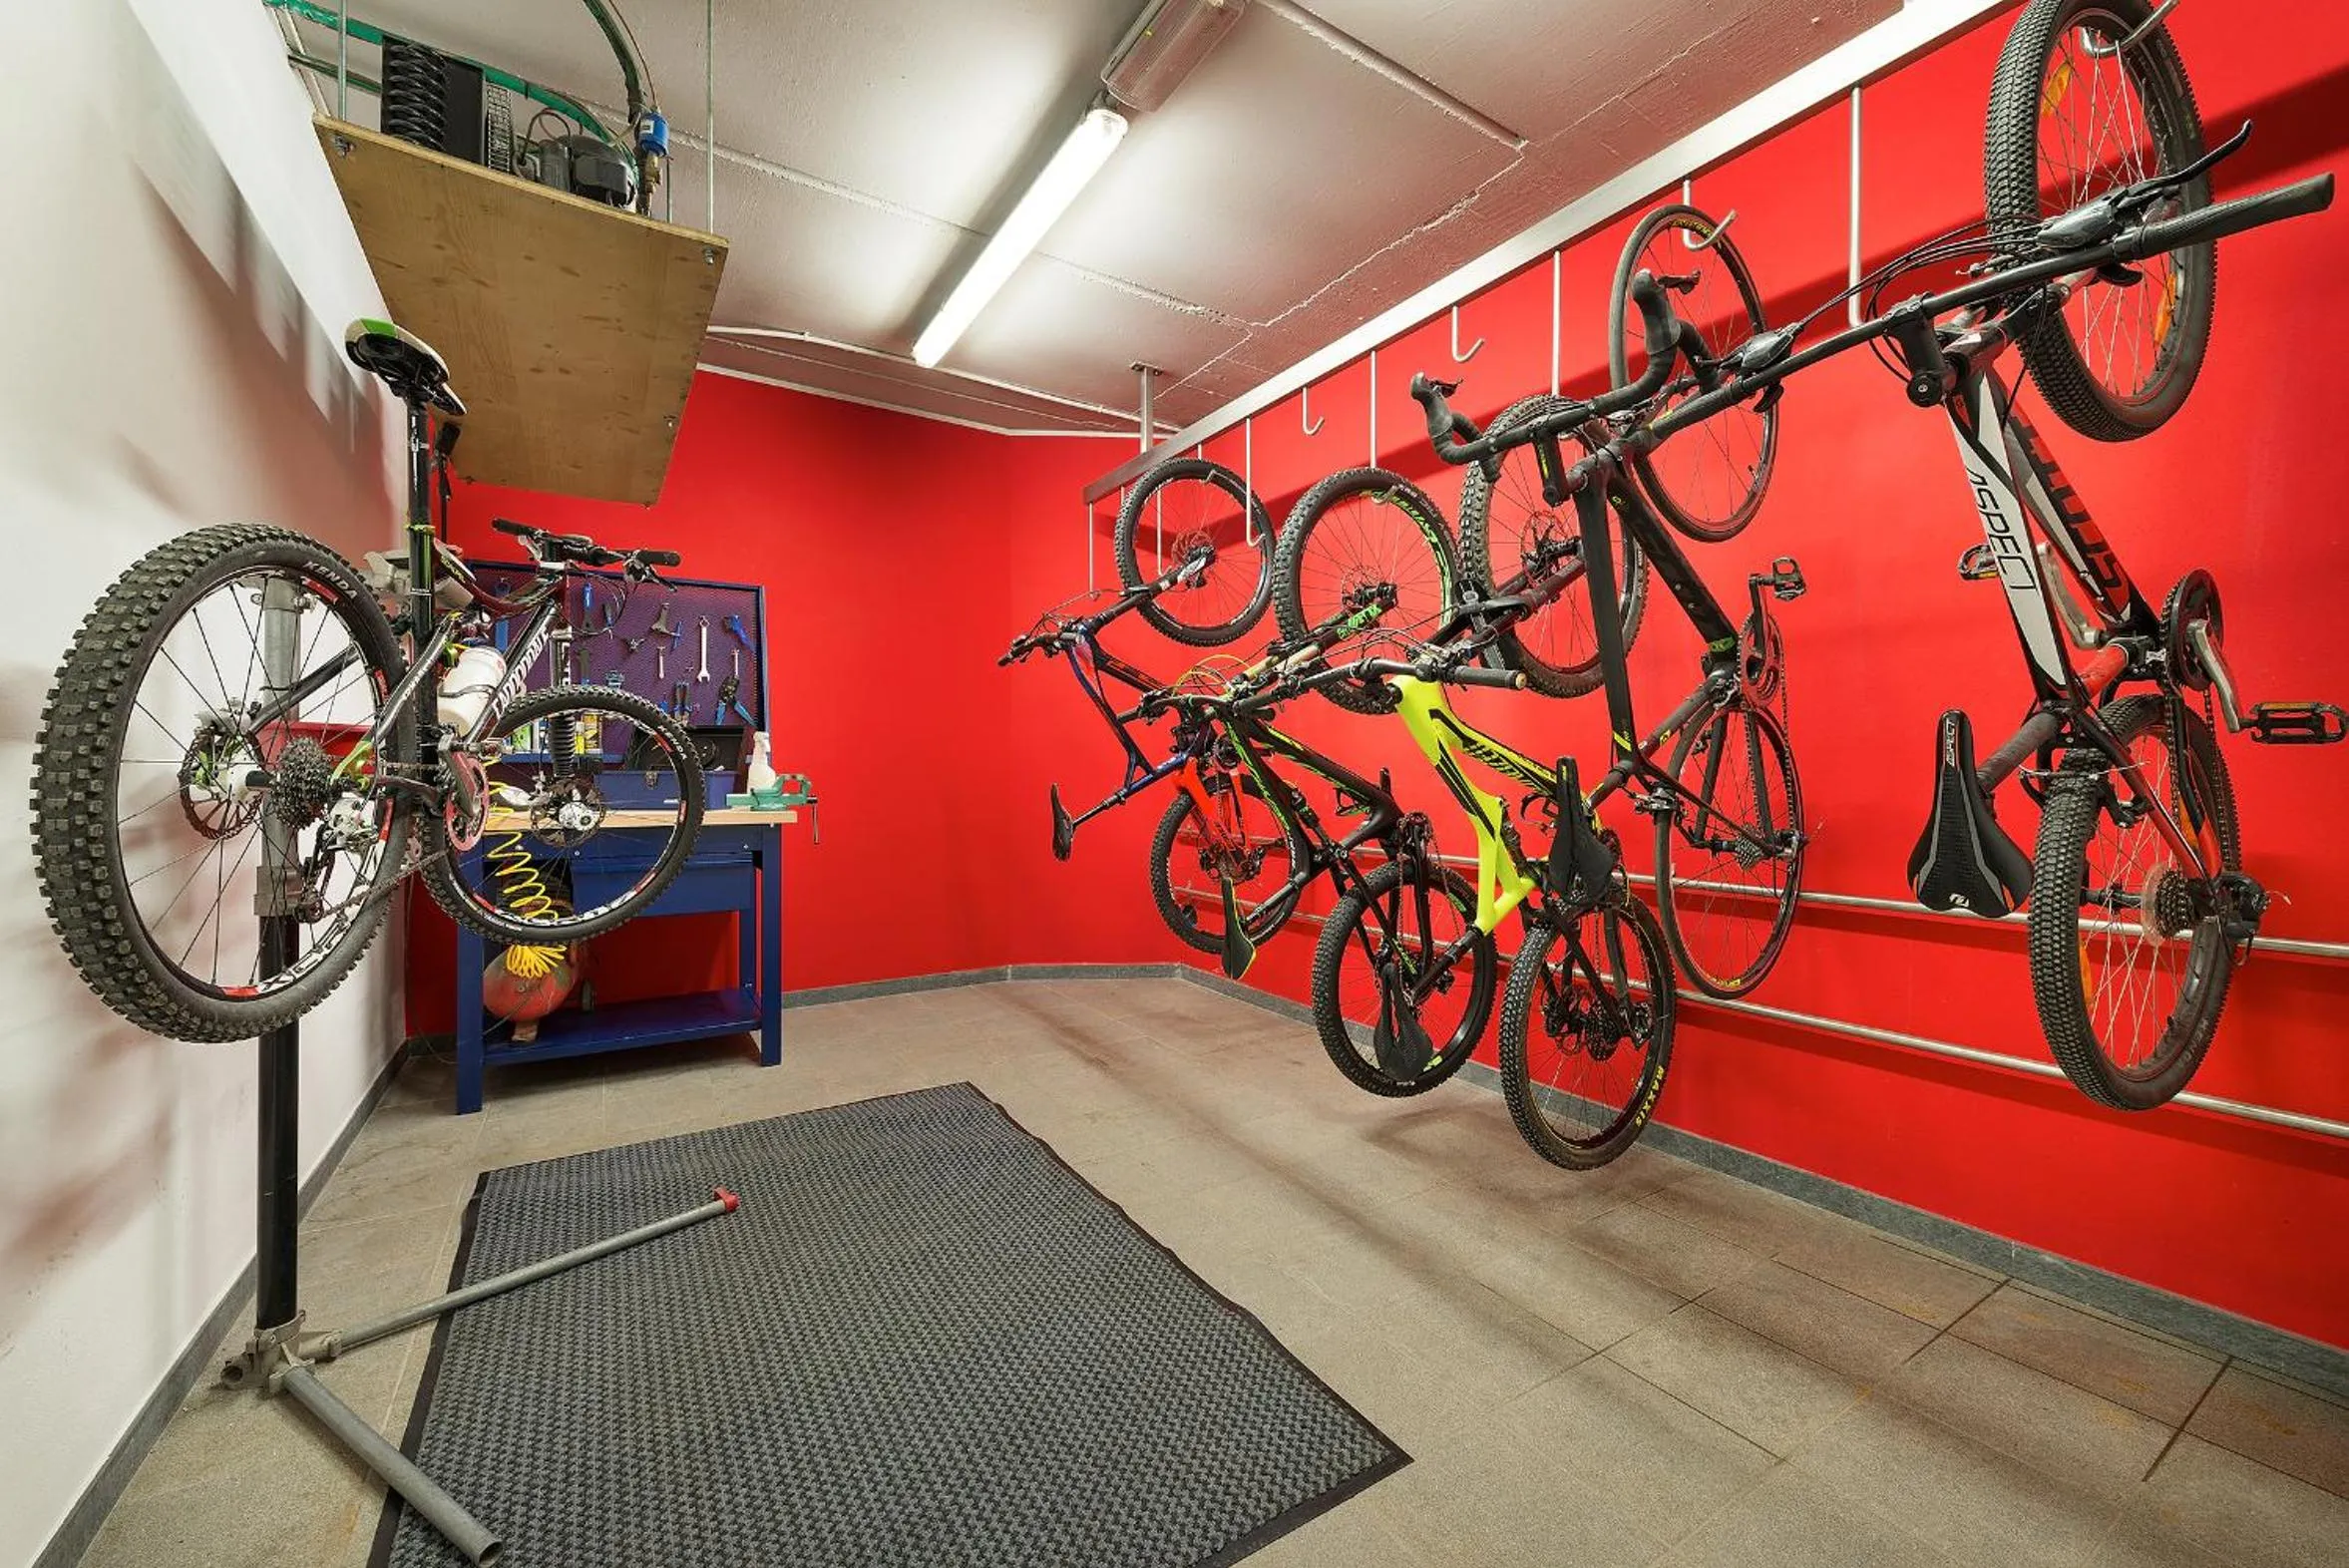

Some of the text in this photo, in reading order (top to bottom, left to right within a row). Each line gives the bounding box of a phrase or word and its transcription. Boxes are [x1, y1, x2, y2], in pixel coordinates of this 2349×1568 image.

[302, 561, 358, 600] KENDA
[657, 724, 688, 761] KENDA
[1635, 1064, 1664, 1127] MAXXIS
